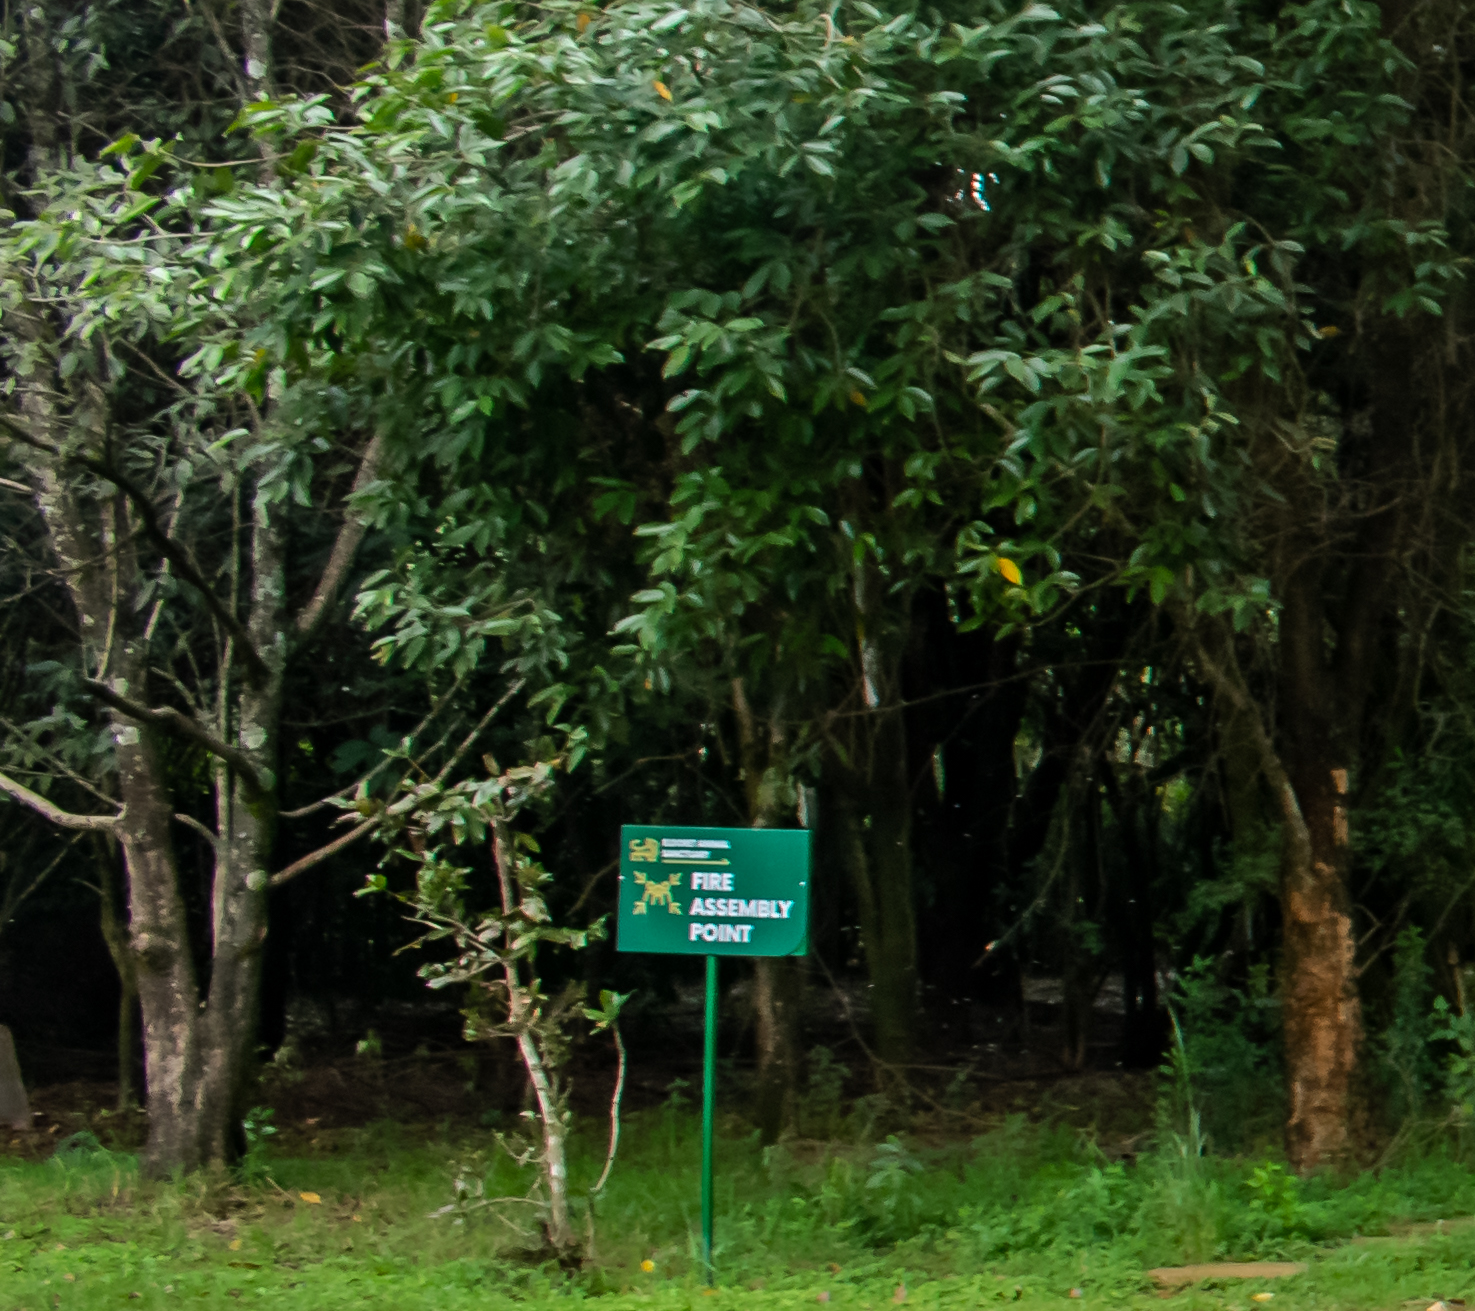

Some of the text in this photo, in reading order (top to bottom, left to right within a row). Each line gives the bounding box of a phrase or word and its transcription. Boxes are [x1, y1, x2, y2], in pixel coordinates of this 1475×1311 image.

[691, 872, 732, 891] FIRE
[689, 898, 791, 918] ASSEMBLY
[690, 923, 751, 942] POINT
